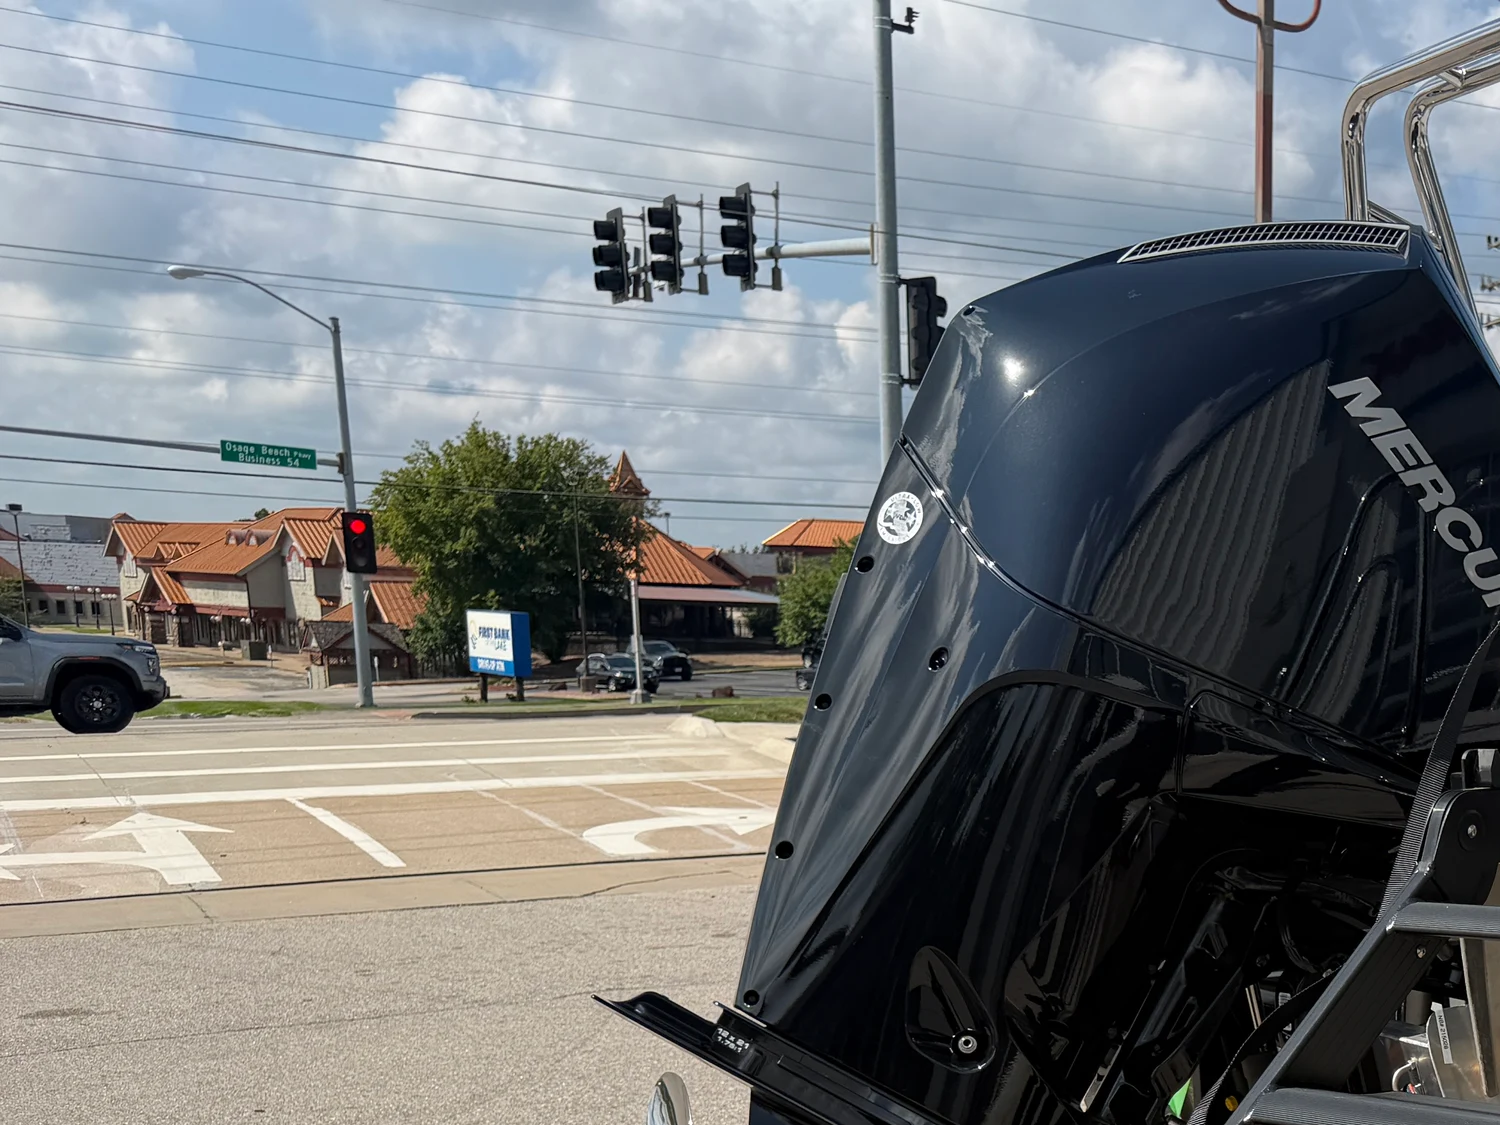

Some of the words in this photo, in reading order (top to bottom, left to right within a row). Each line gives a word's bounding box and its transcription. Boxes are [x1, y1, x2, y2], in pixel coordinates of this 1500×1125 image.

[225, 442, 255, 455] Osage
[261, 445, 290, 457] Beach
[238, 452, 281, 466] Business
[286, 457, 300, 467] 54
[717, 1027, 730, 1038] 12
[736, 1038, 750, 1050] 21
